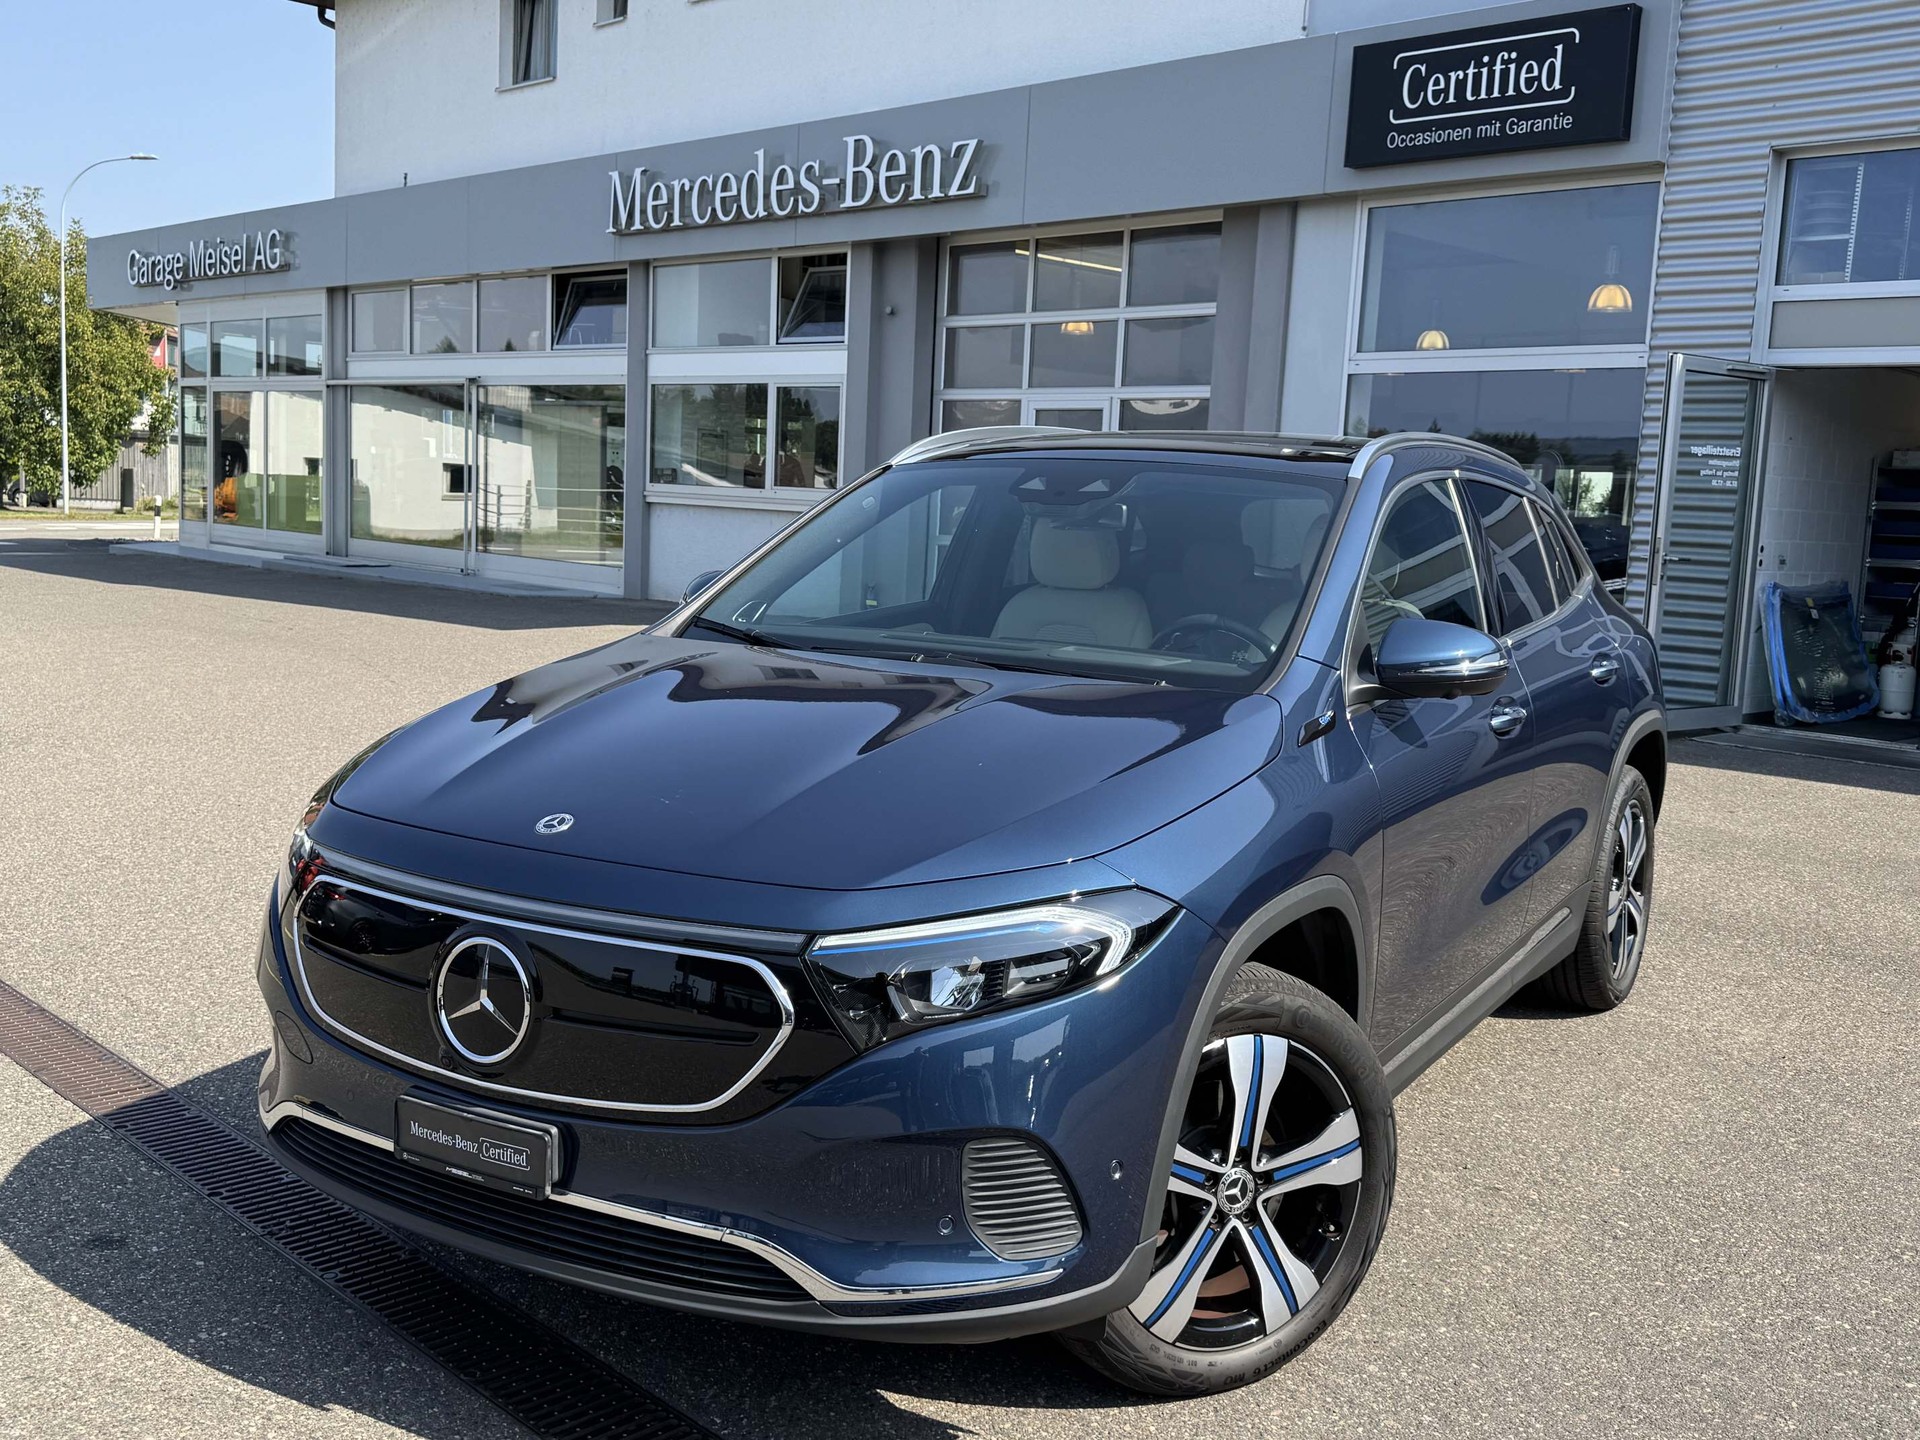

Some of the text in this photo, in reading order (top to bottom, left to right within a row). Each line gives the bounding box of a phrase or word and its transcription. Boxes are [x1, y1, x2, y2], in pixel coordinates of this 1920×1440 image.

[1402, 44, 1564, 110] Certified
[1387, 112, 1573, 149] Occasionen mit Garantie
[606, 133, 984, 234] Mercedes-Benz
[127, 228, 281, 291] Garage Meisel AG
[410, 1121, 527, 1166] Mercedes-Benz Certified
